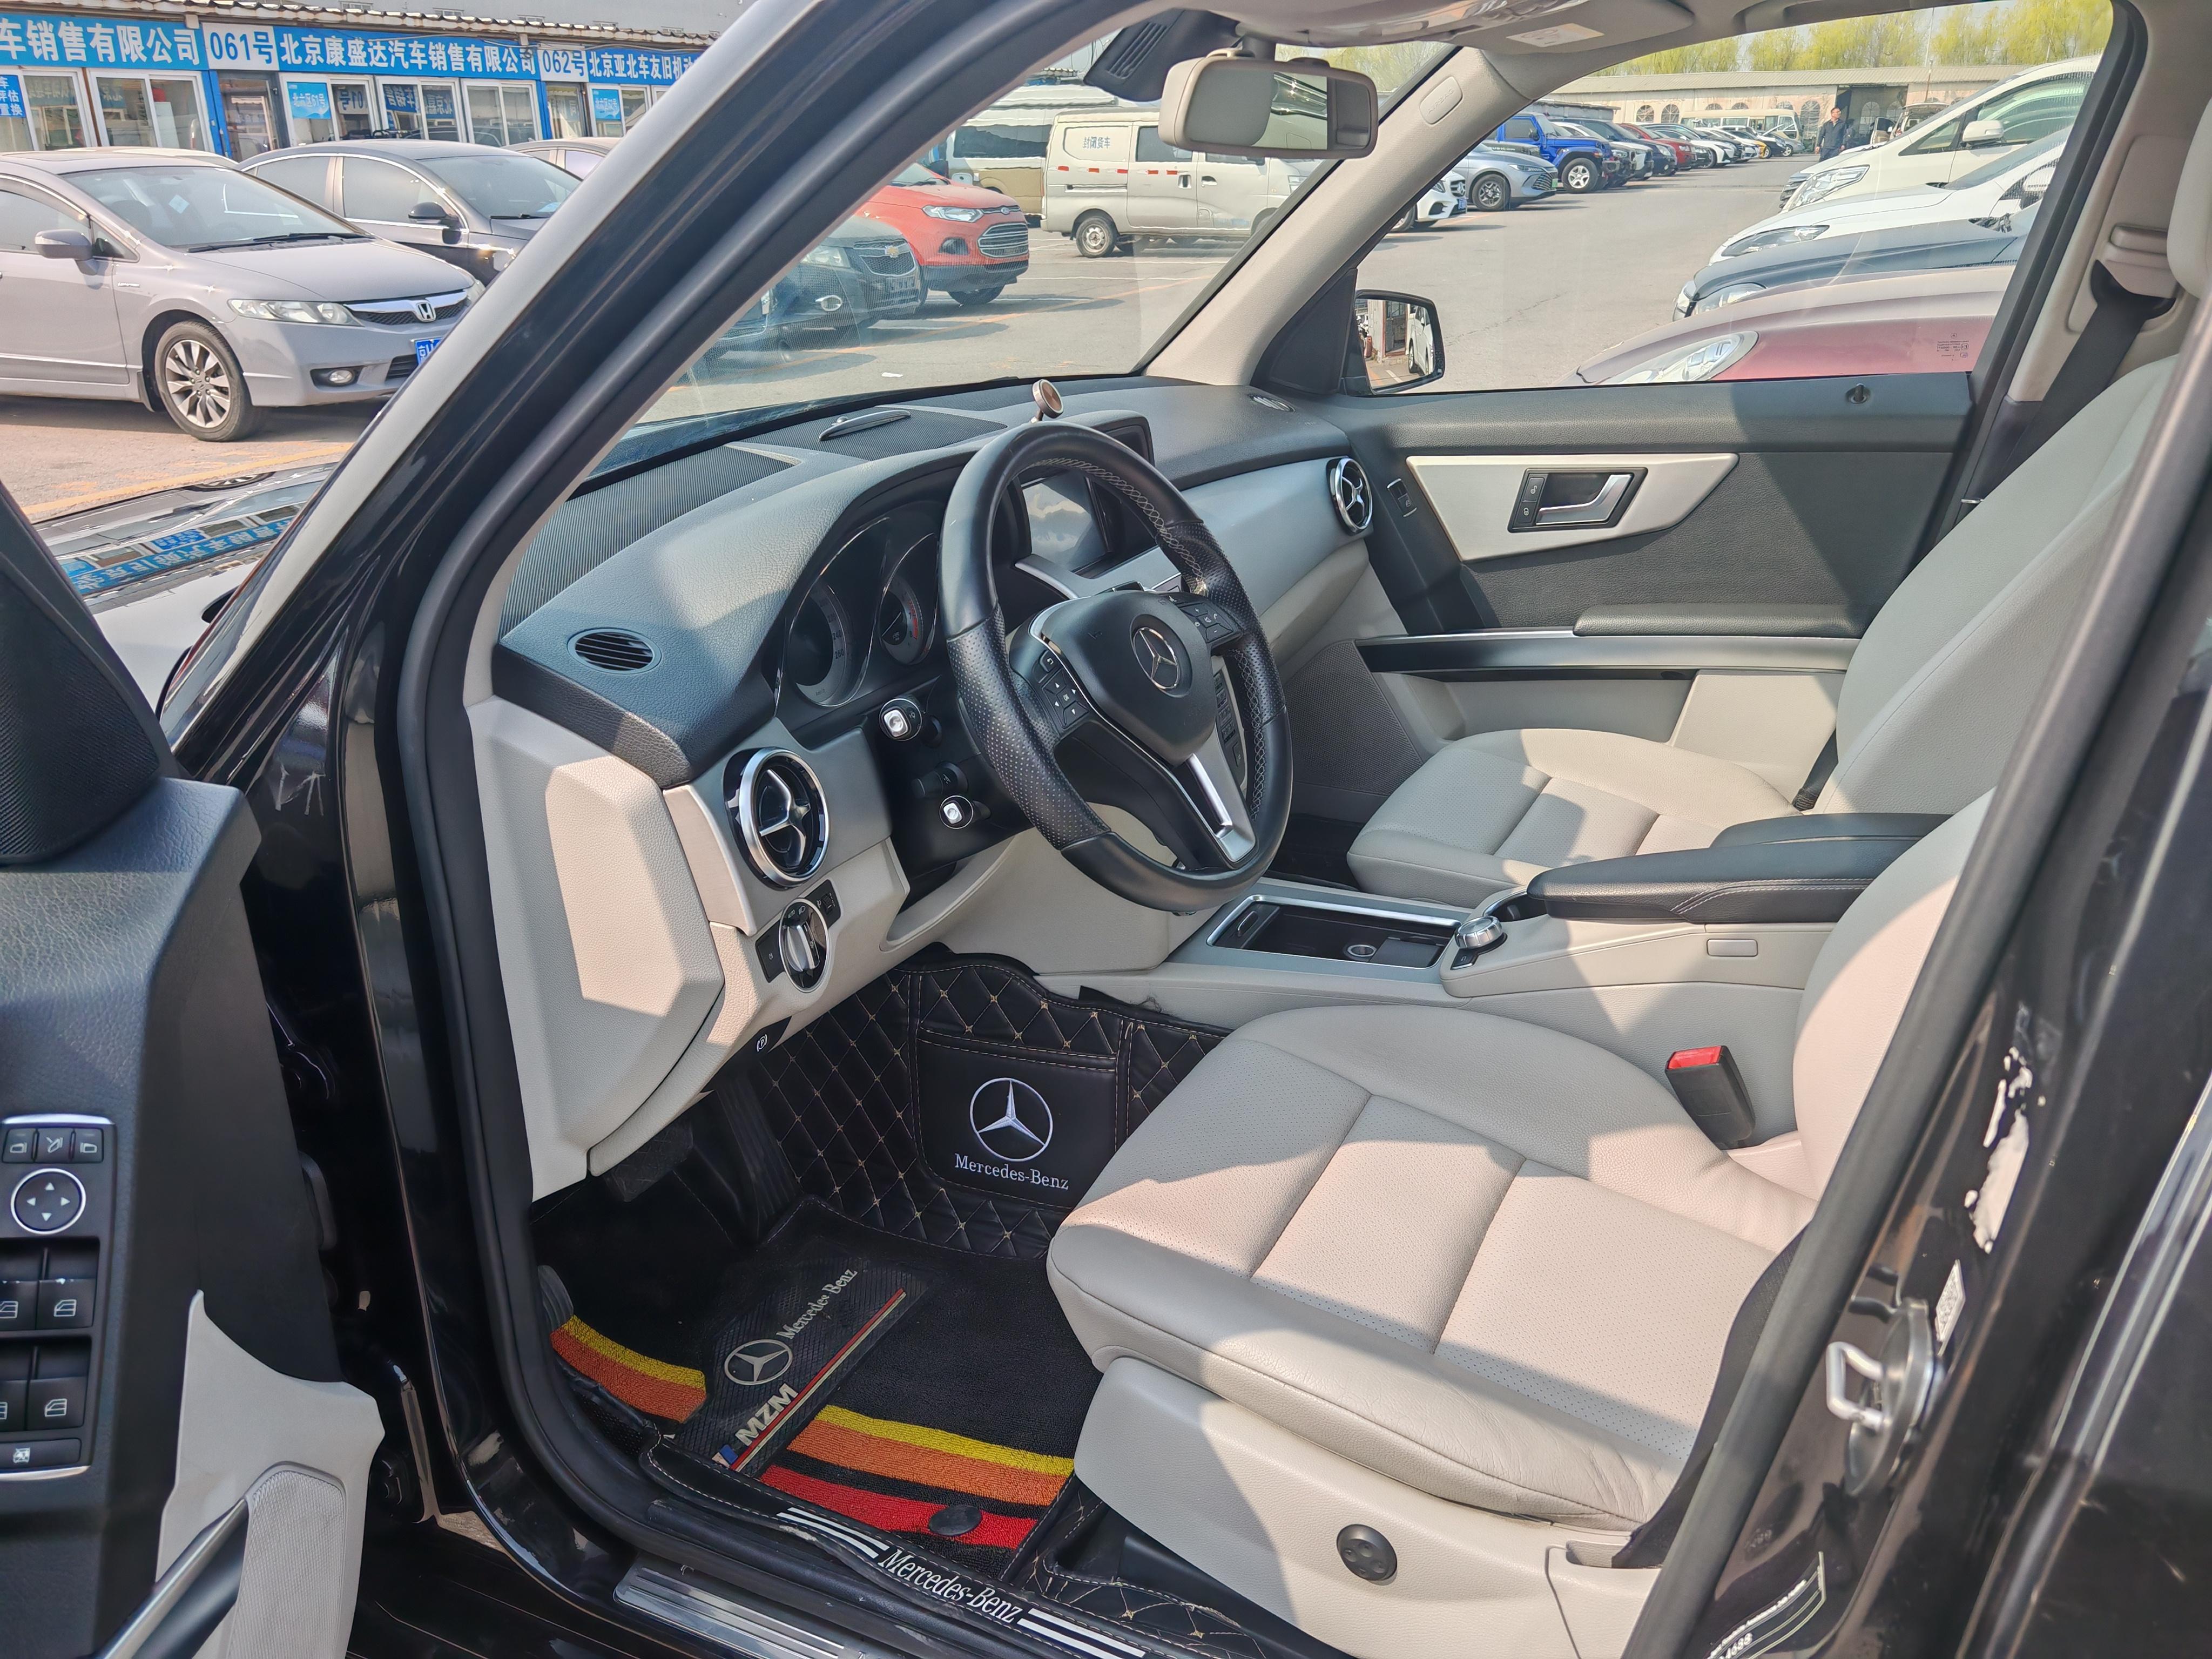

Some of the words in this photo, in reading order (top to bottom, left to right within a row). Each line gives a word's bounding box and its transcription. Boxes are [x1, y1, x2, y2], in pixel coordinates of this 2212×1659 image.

[0, 18, 200, 65] 车销售有限公司
[210, 30, 272, 64] 061号
[280, 33, 536, 75] 北京康盛达汽车销售有限公司
[542, 50, 585, 77] 062号
[1082, 136, 1111, 149] 封闭货车
[834, 649, 845, 659] 260
[954, 1153, 1069, 1190] Mercedes-Benz
[734, 1382, 799, 1446] MZM
[878, 1548, 1023, 1623] Mercedes-Benz
